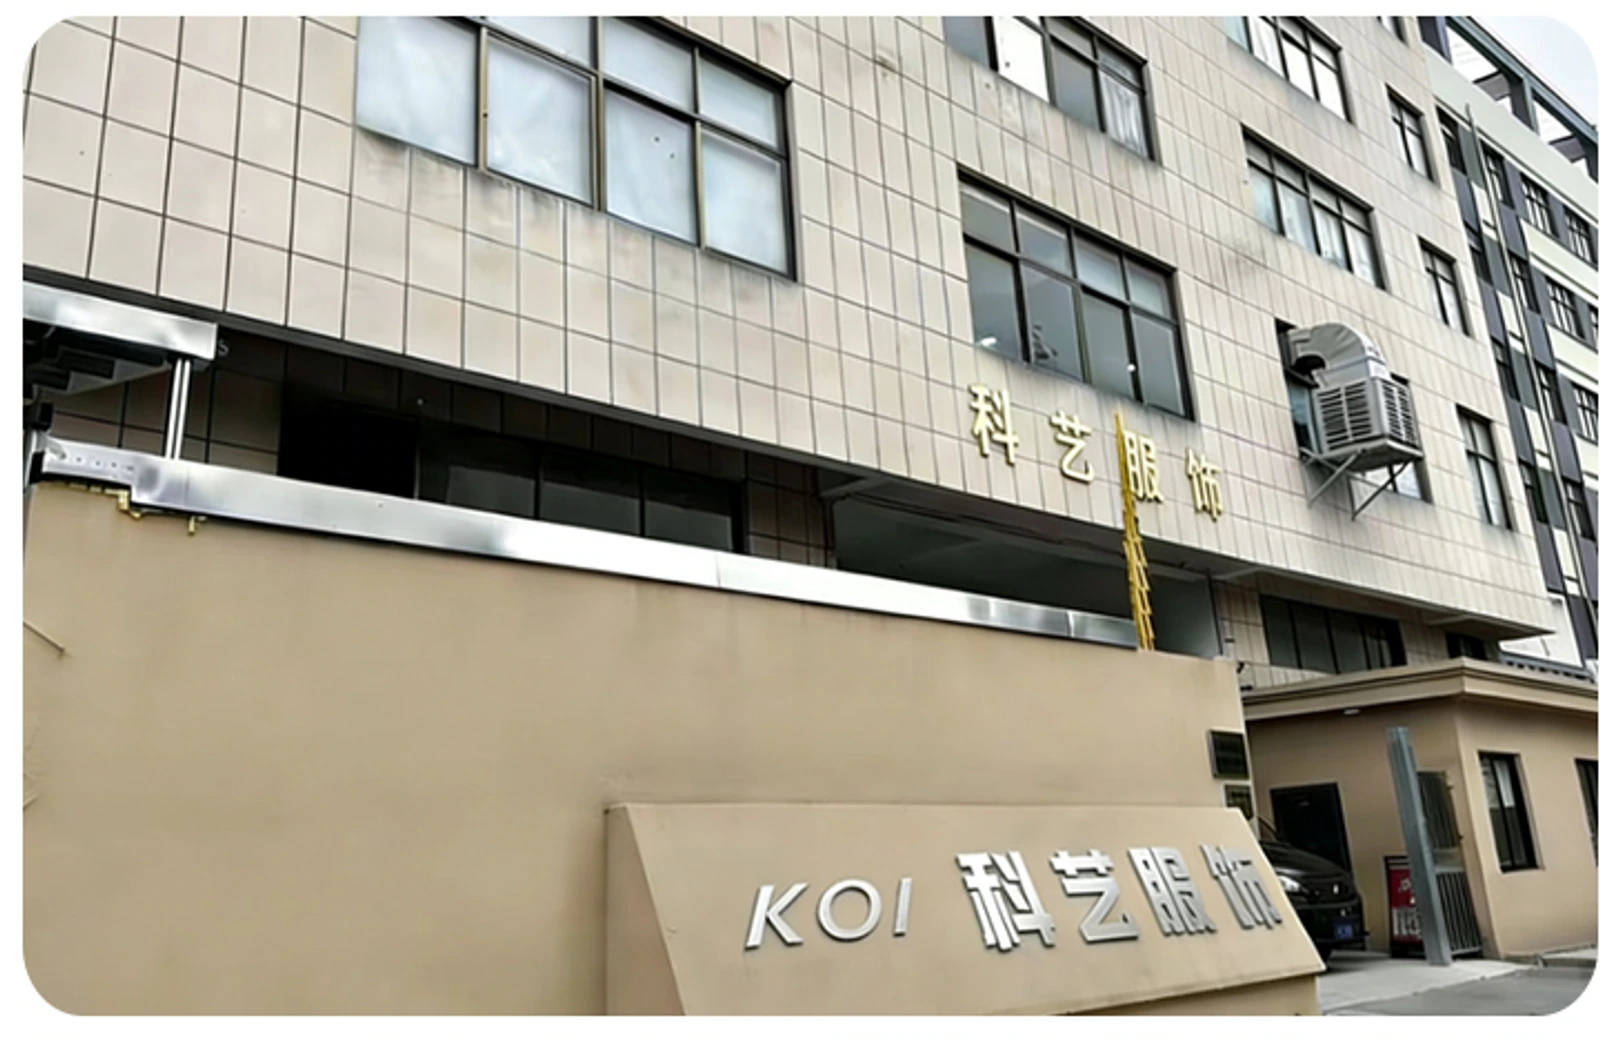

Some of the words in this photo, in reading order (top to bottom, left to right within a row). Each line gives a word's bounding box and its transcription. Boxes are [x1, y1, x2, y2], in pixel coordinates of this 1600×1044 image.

[968, 383, 1223, 522] 科艺服饰
[745, 877, 913, 950] KOI
[956, 843, 1282, 952] 科艺服饰
